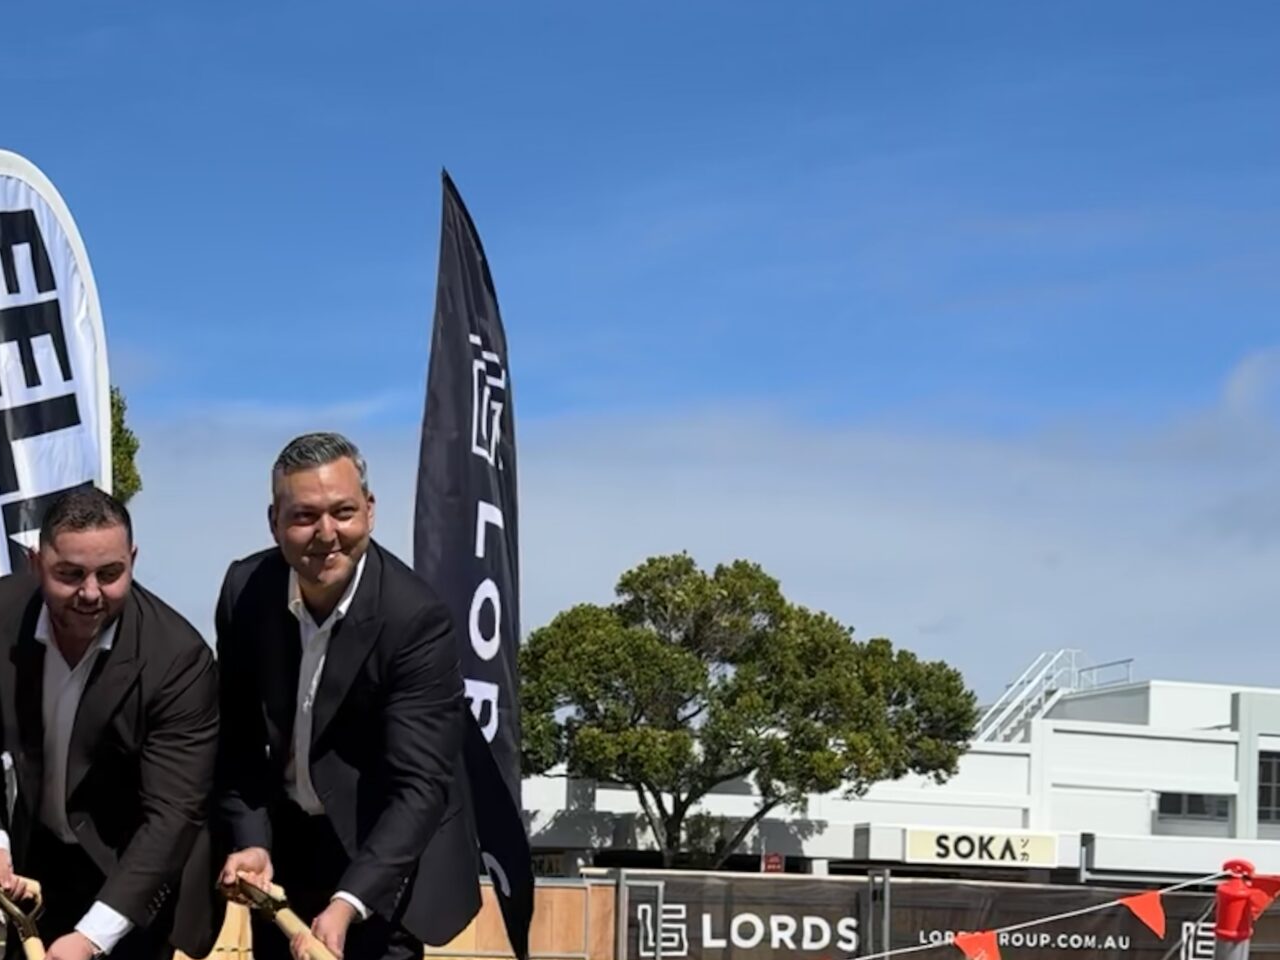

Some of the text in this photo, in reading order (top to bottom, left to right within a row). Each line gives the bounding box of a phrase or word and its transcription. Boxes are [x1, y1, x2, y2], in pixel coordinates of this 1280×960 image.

[935, 833, 1018, 861] SOKA
[702, 913, 860, 952] LORDS
[920, 929, 1131, 949] LORROUP.COM.AU
